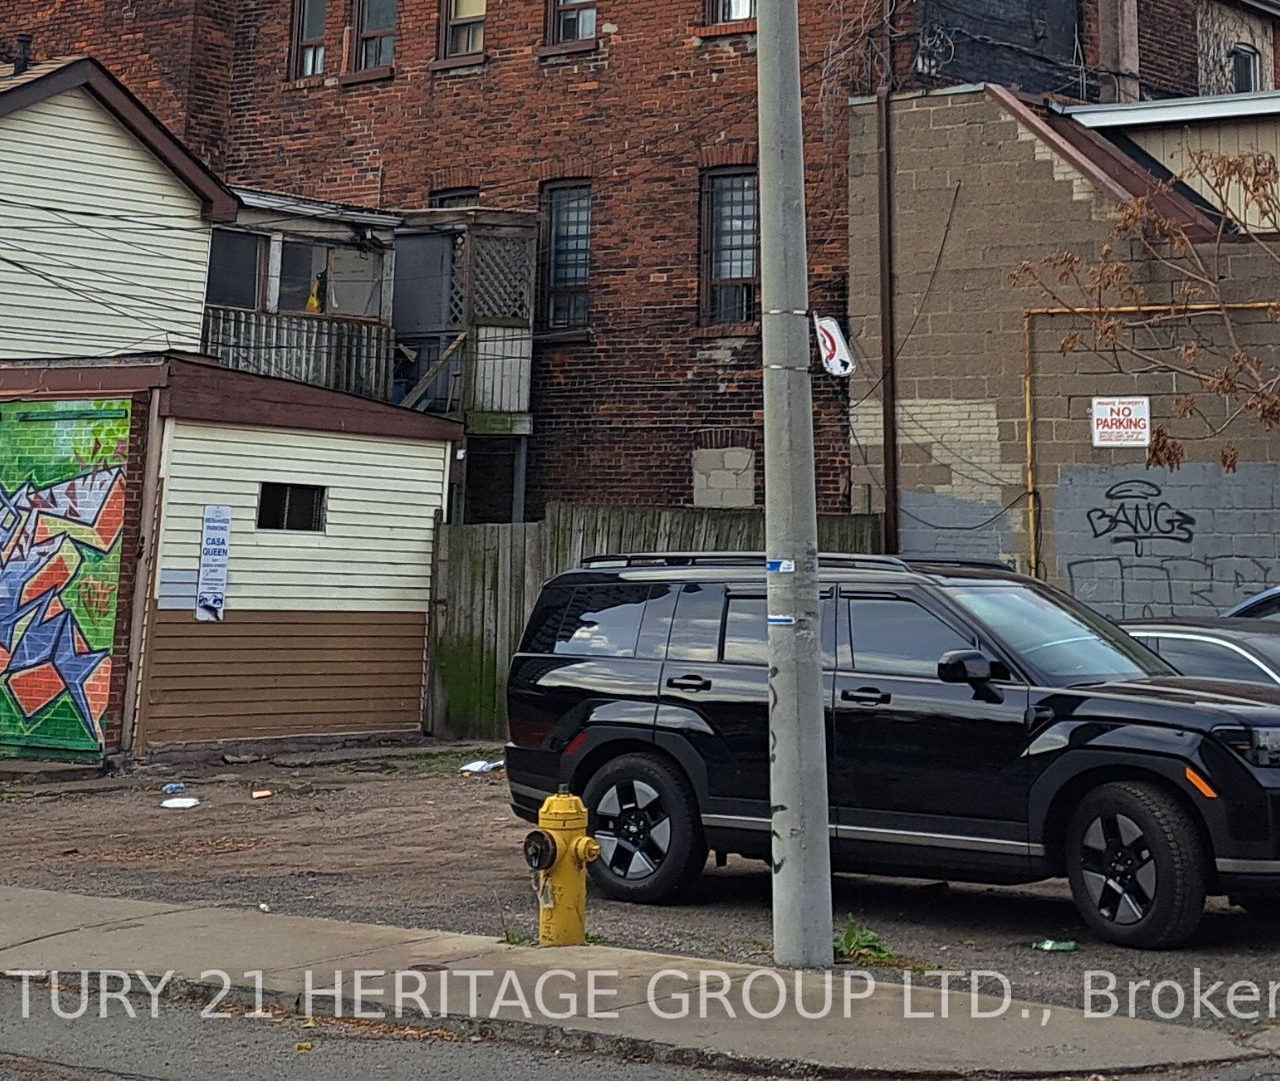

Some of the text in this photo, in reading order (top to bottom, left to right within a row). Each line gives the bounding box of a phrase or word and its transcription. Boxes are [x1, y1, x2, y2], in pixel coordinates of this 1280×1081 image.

[1110, 407, 1132, 417] NO
[1096, 418, 1147, 430] PARKING
[206, 537, 226, 547] CASA
[202, 547, 228, 557] QUEEN
